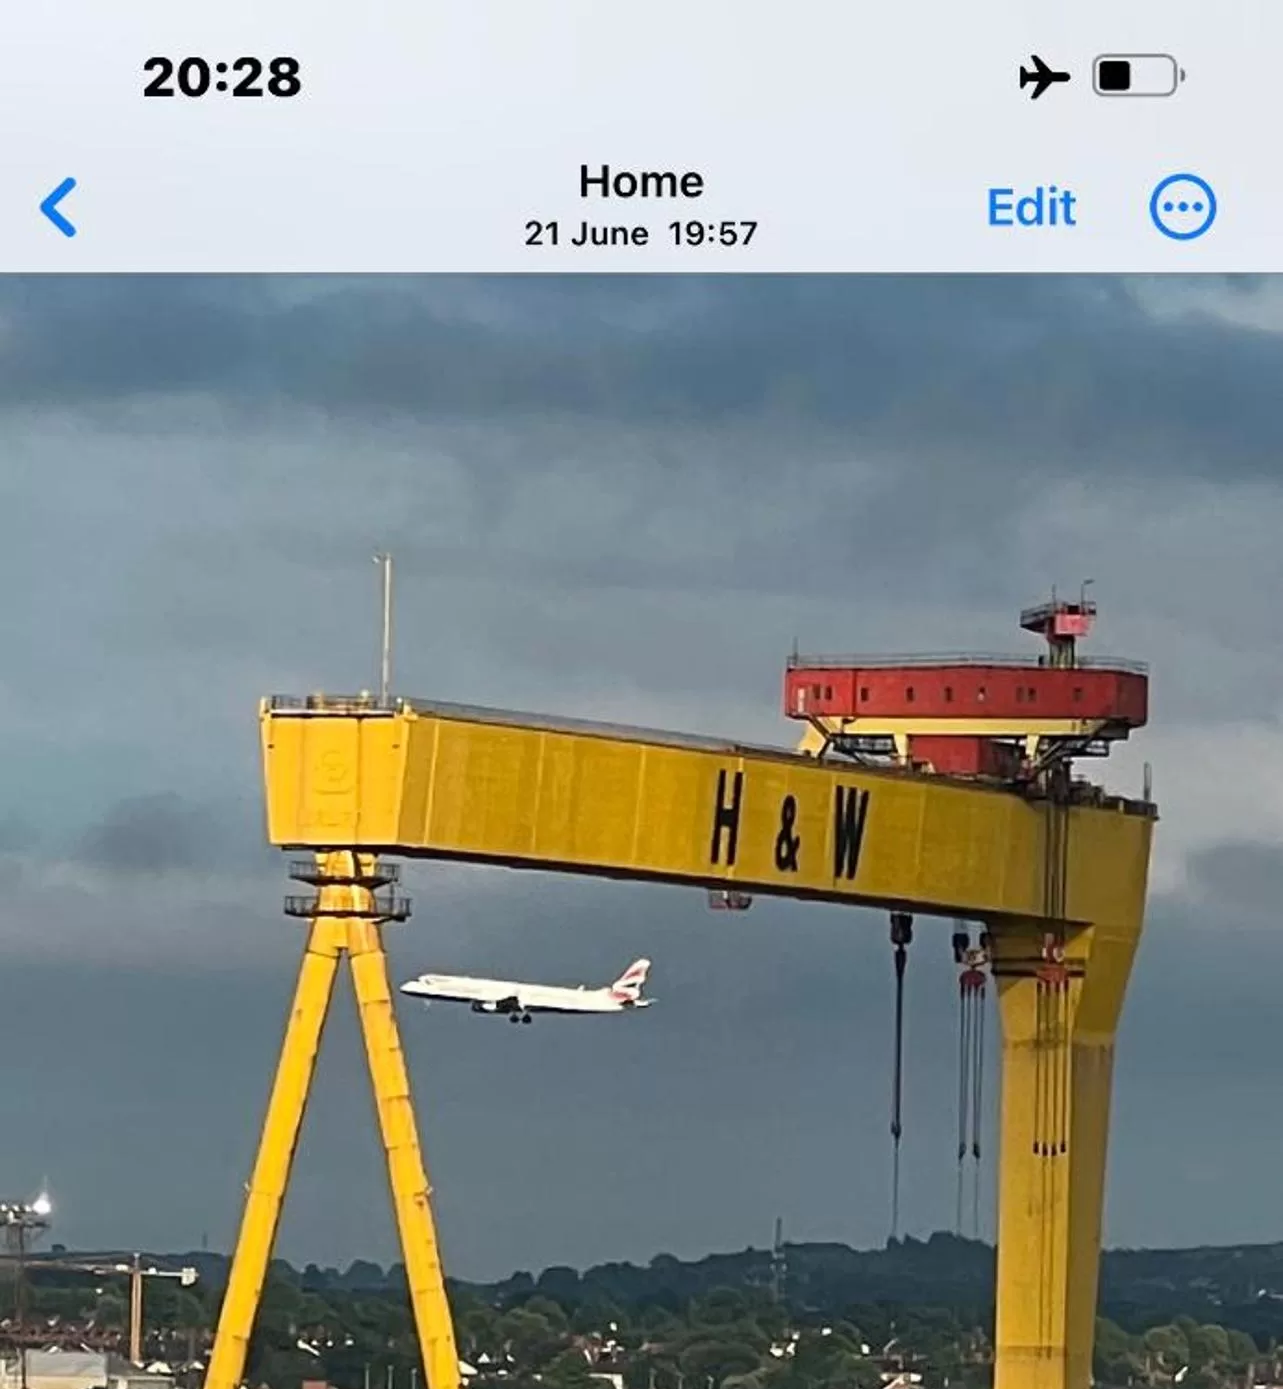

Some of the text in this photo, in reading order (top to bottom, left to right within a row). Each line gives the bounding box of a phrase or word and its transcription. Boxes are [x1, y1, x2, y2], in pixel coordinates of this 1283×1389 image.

[711, 769, 870, 880] H & W
